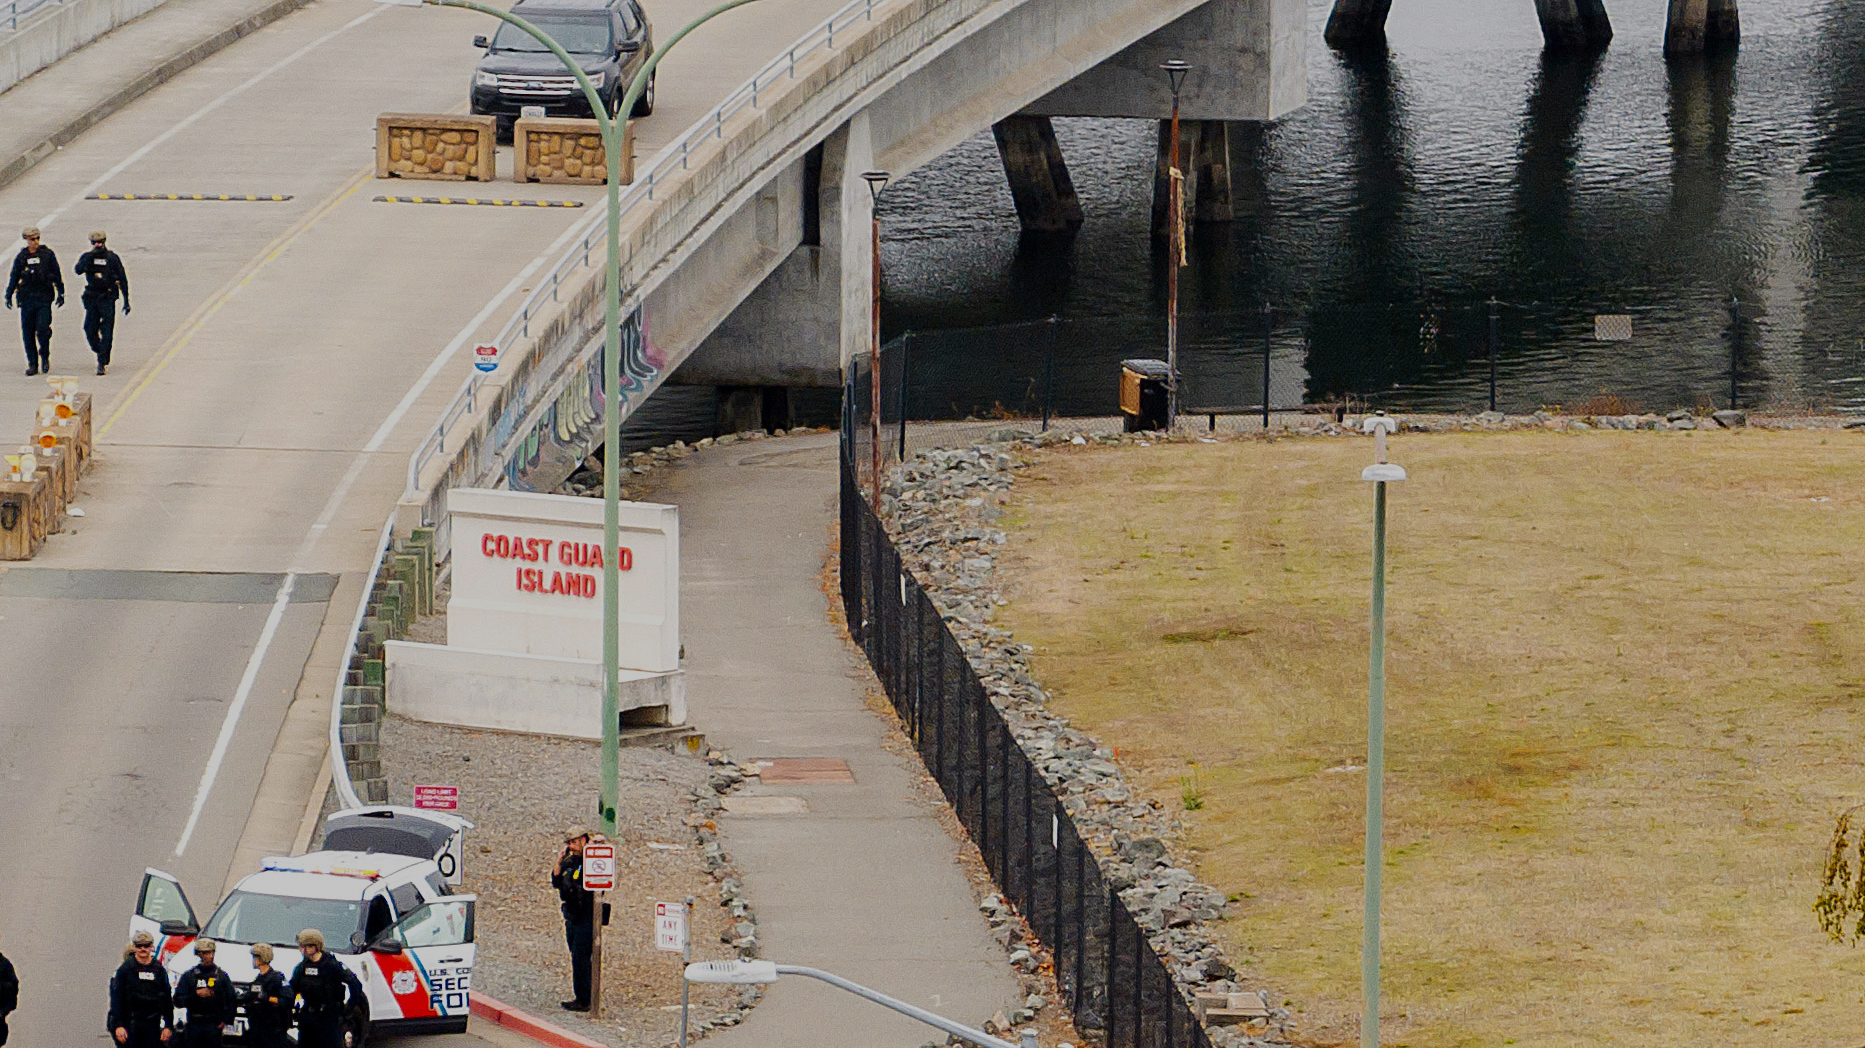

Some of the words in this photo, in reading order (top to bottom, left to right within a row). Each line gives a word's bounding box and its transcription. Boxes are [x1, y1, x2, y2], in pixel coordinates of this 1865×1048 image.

[481, 533, 553, 560] COAST
[558, 541, 633, 572] GUAD
[516, 567, 596, 598] ISLAND
[662, 934, 678, 946] TIME
[430, 992, 469, 1009] FO
